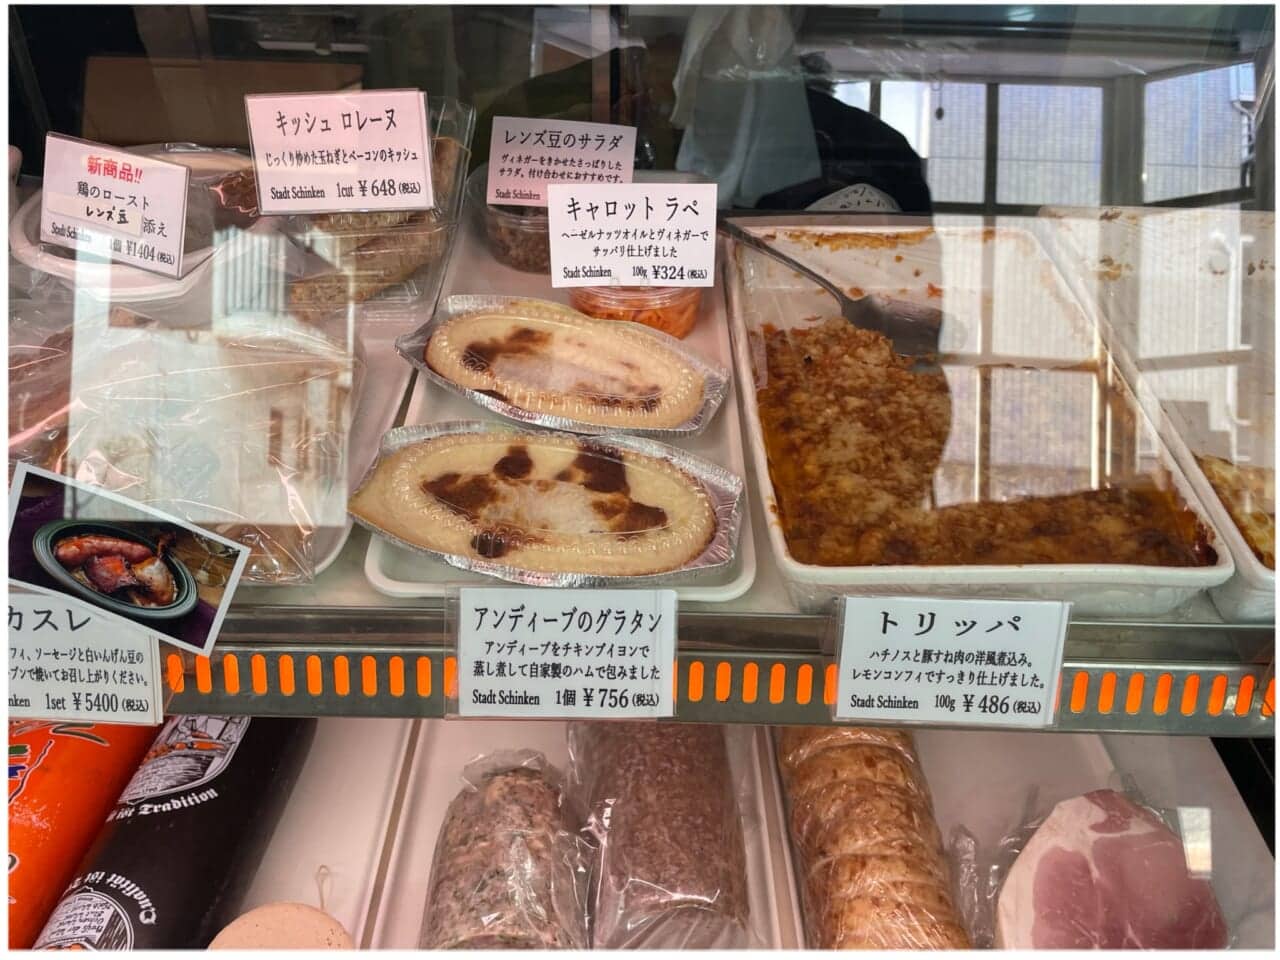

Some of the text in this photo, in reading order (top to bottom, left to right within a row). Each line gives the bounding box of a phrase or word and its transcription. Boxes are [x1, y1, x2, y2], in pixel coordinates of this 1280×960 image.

[275, 108, 397, 137] キッシュ ロレーヌ
[505, 129, 624, 152] レンズ豆のサラダ
[87, 155, 144, 184] 新商品!!
[77, 180, 151, 211] 鶏のロースト
[271, 186, 291, 201] Stadt
[291, 185, 326, 200] Schinken
[336, 182, 355, 199] 1cut
[86, 205, 129, 224] レンズ豆
[566, 196, 700, 222] キャロット ラペ
[142, 217, 168, 238] 添え
[592, 245, 679, 259] サッパリ仕上げました
[563, 266, 581, 280] Stadt
[581, 265, 612, 279] Schinken
[632, 265, 648, 280] 100g
[652, 264, 685, 280] ¥324
[474, 603, 663, 635] アンディーブのグラタン
[880, 610, 1022, 637] トリッパ
[472, 660, 662, 681] 蒸し煮して自家製のハムで包みました
[852, 668, 1046, 690] レモンコンフィですっきり仕上げました。
[45, 692, 67, 711] 1set
[472, 688, 497, 705] Stadt
[498, 688, 541, 707] Schinken
[555, 688, 577, 707] 1個
[850, 693, 876, 709] Stadt
[876, 693, 920, 711] Schinken
[935, 694, 956, 712] 100g
[138, 788, 219, 816] Tradition
